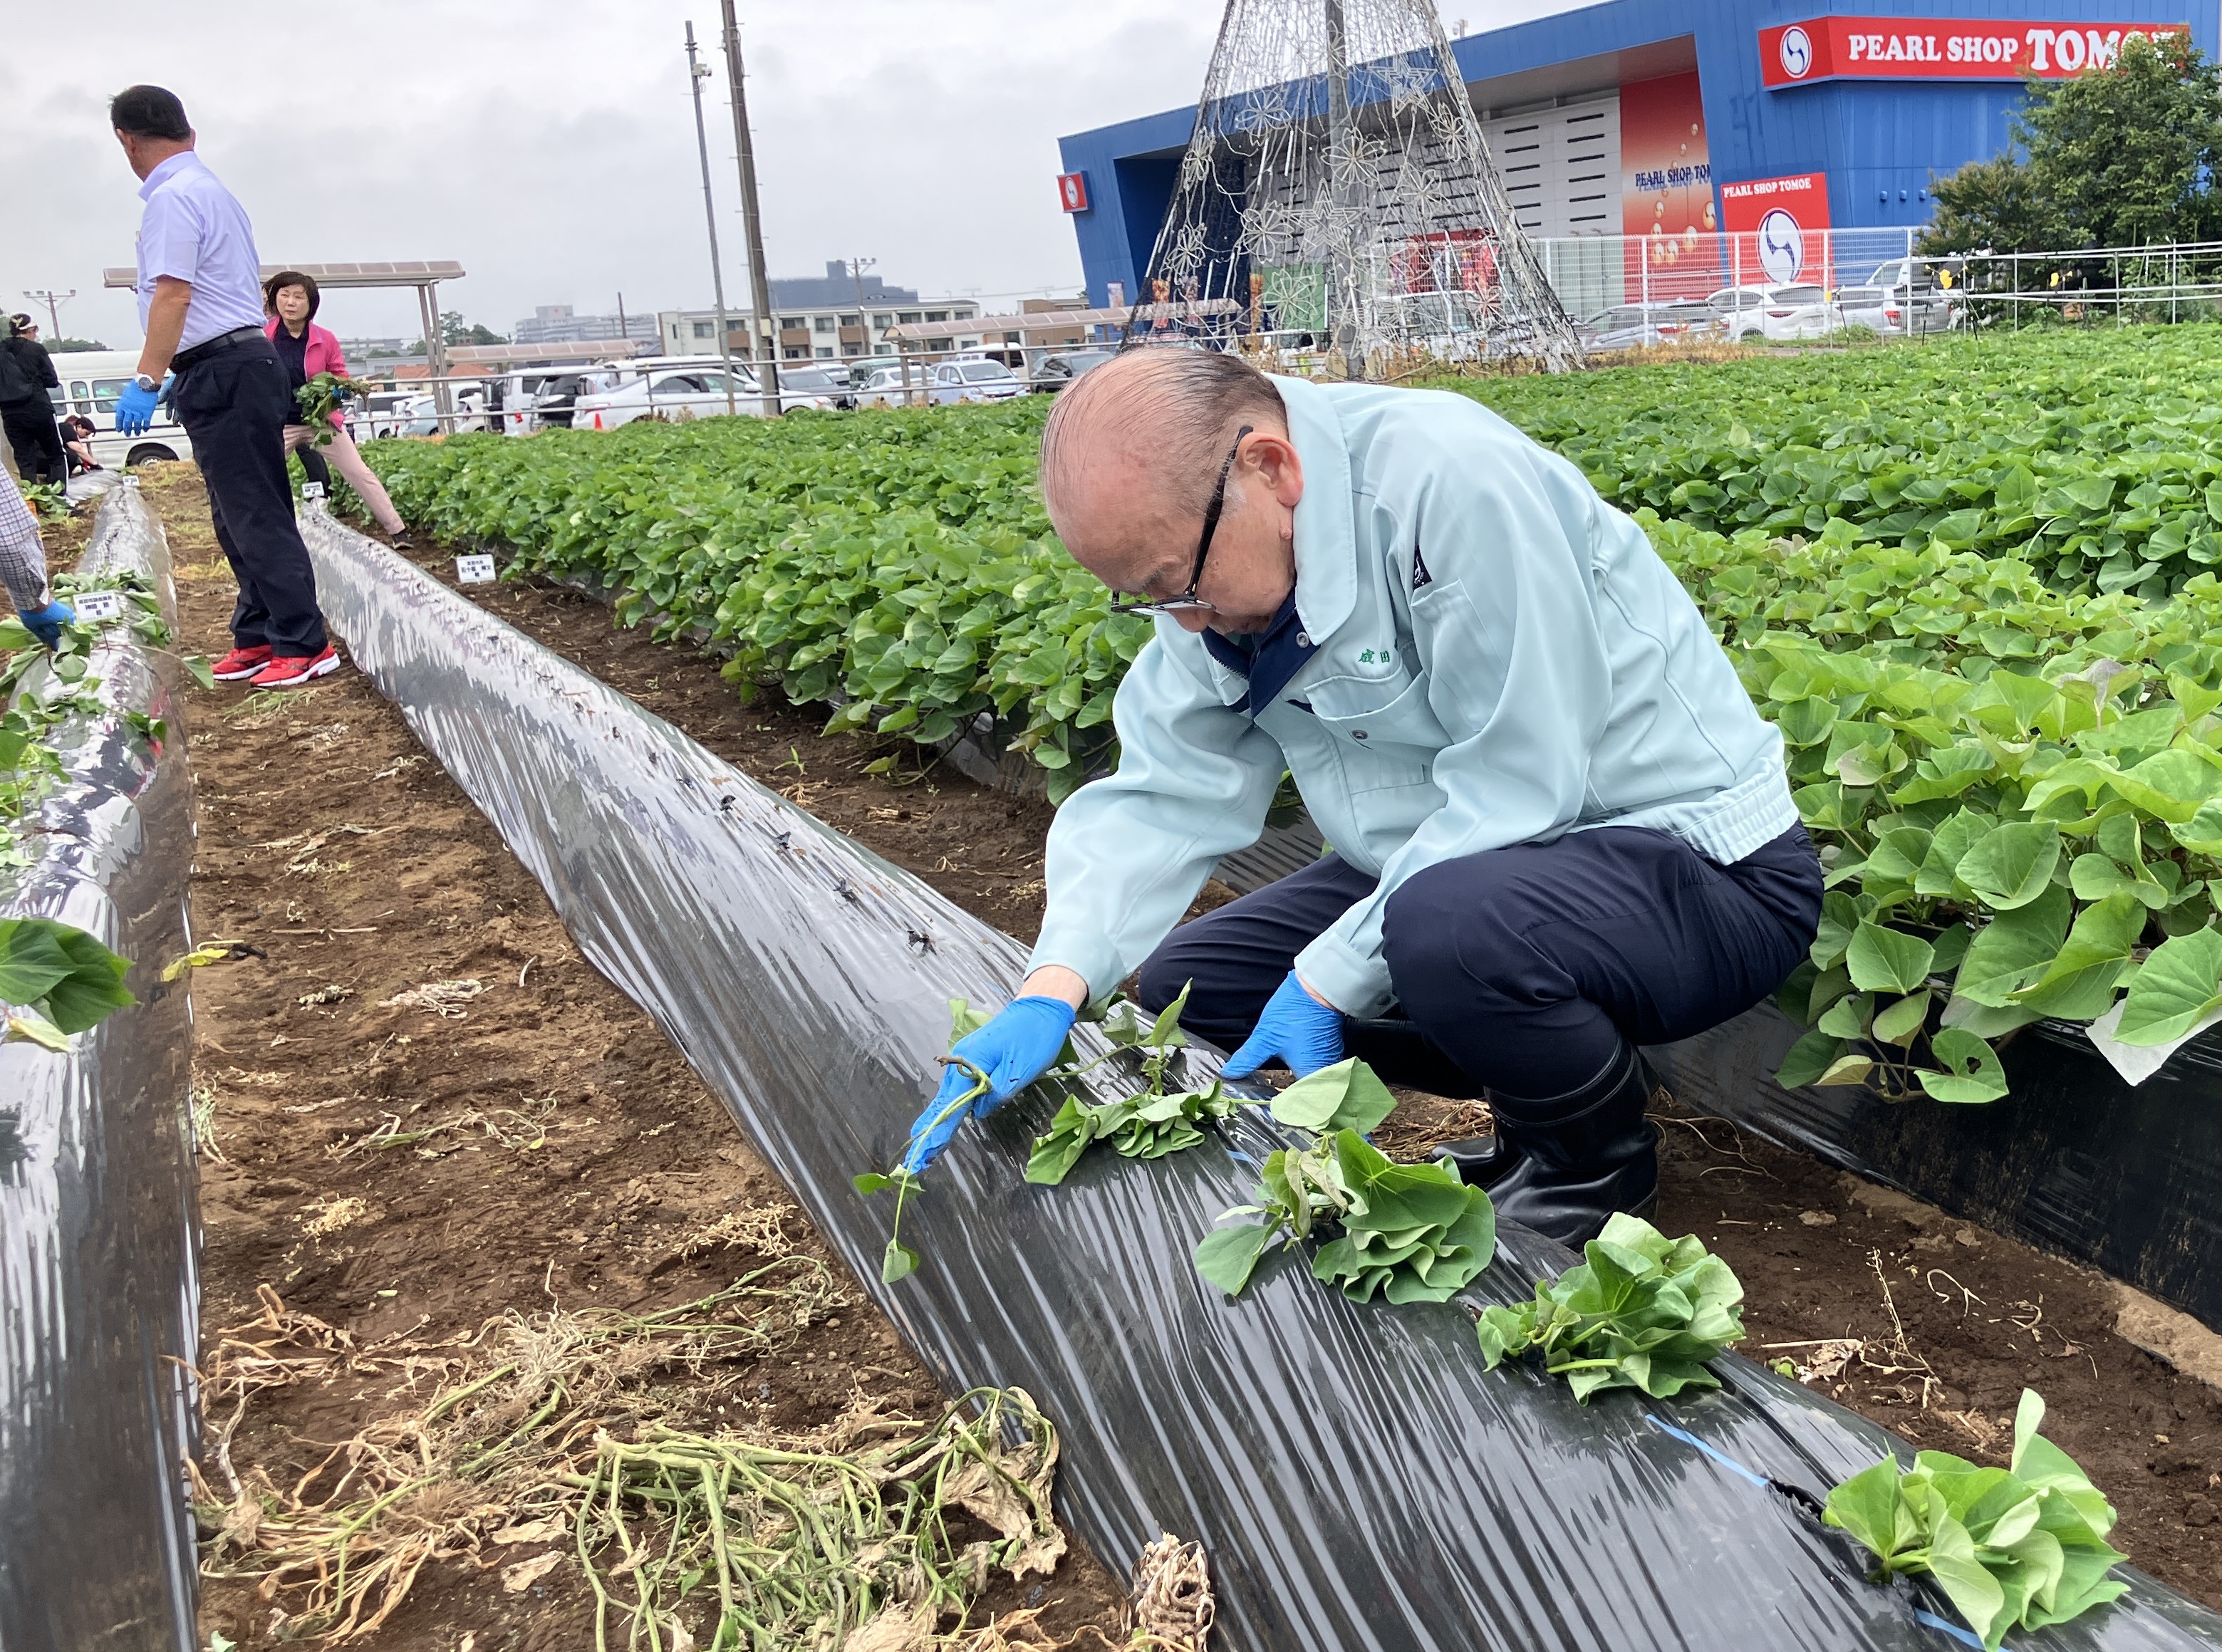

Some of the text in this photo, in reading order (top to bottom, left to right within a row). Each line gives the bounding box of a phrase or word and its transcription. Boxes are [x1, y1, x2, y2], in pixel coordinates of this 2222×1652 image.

[1848, 34, 1942, 61] PEARL
[1946, 36, 2019, 63] SHOP
[1635, 170, 1665, 187] PEARL
[1667, 166, 1691, 182] SHOP
[1723, 177, 1812, 198] PEARL SHOP TOMOE
